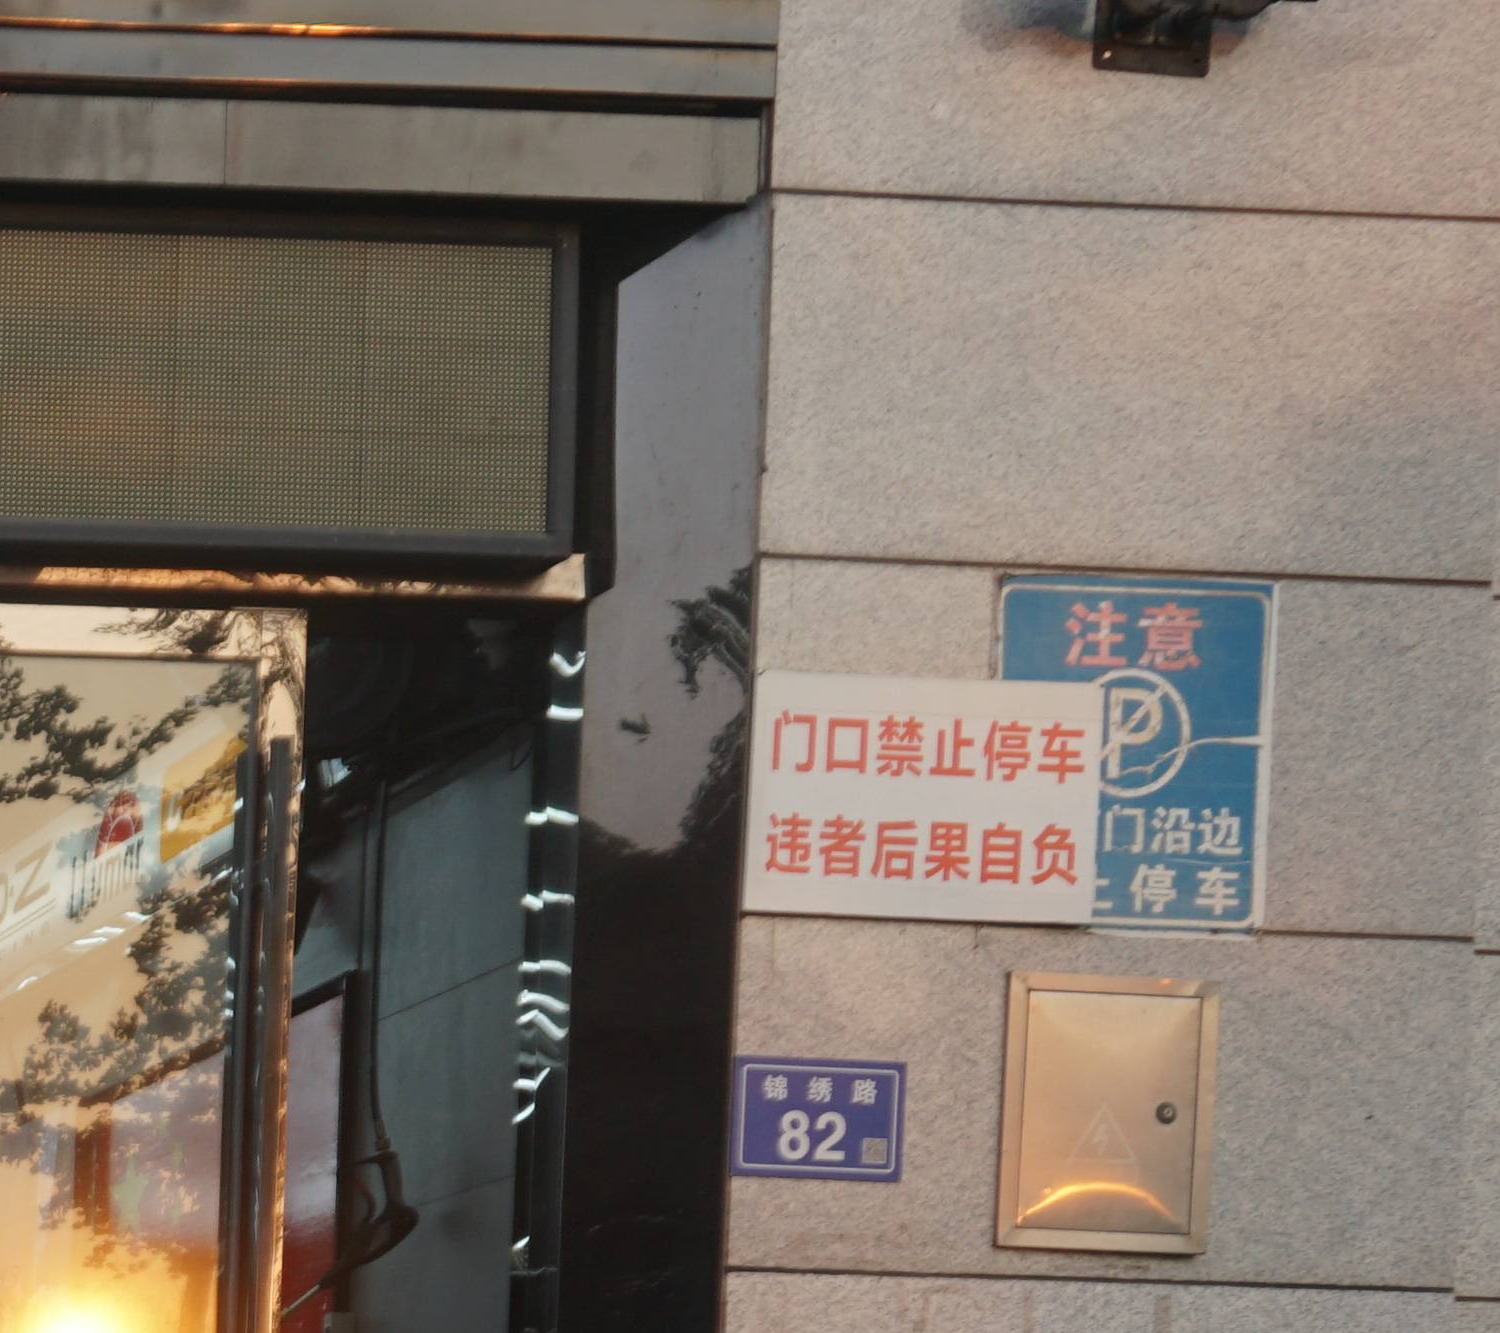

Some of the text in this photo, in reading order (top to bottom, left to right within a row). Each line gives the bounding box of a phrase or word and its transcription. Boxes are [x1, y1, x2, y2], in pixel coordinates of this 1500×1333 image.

[1065, 601, 1203, 671] 注意
[770, 709, 1086, 784] 门口禁止停车
[765, 811, 1080, 887] 违者后果自负
[1099, 804, 1243, 855] 门沿边
[764, 1074, 878, 1105] 锦绣路
[779, 1110, 847, 1161] 82
